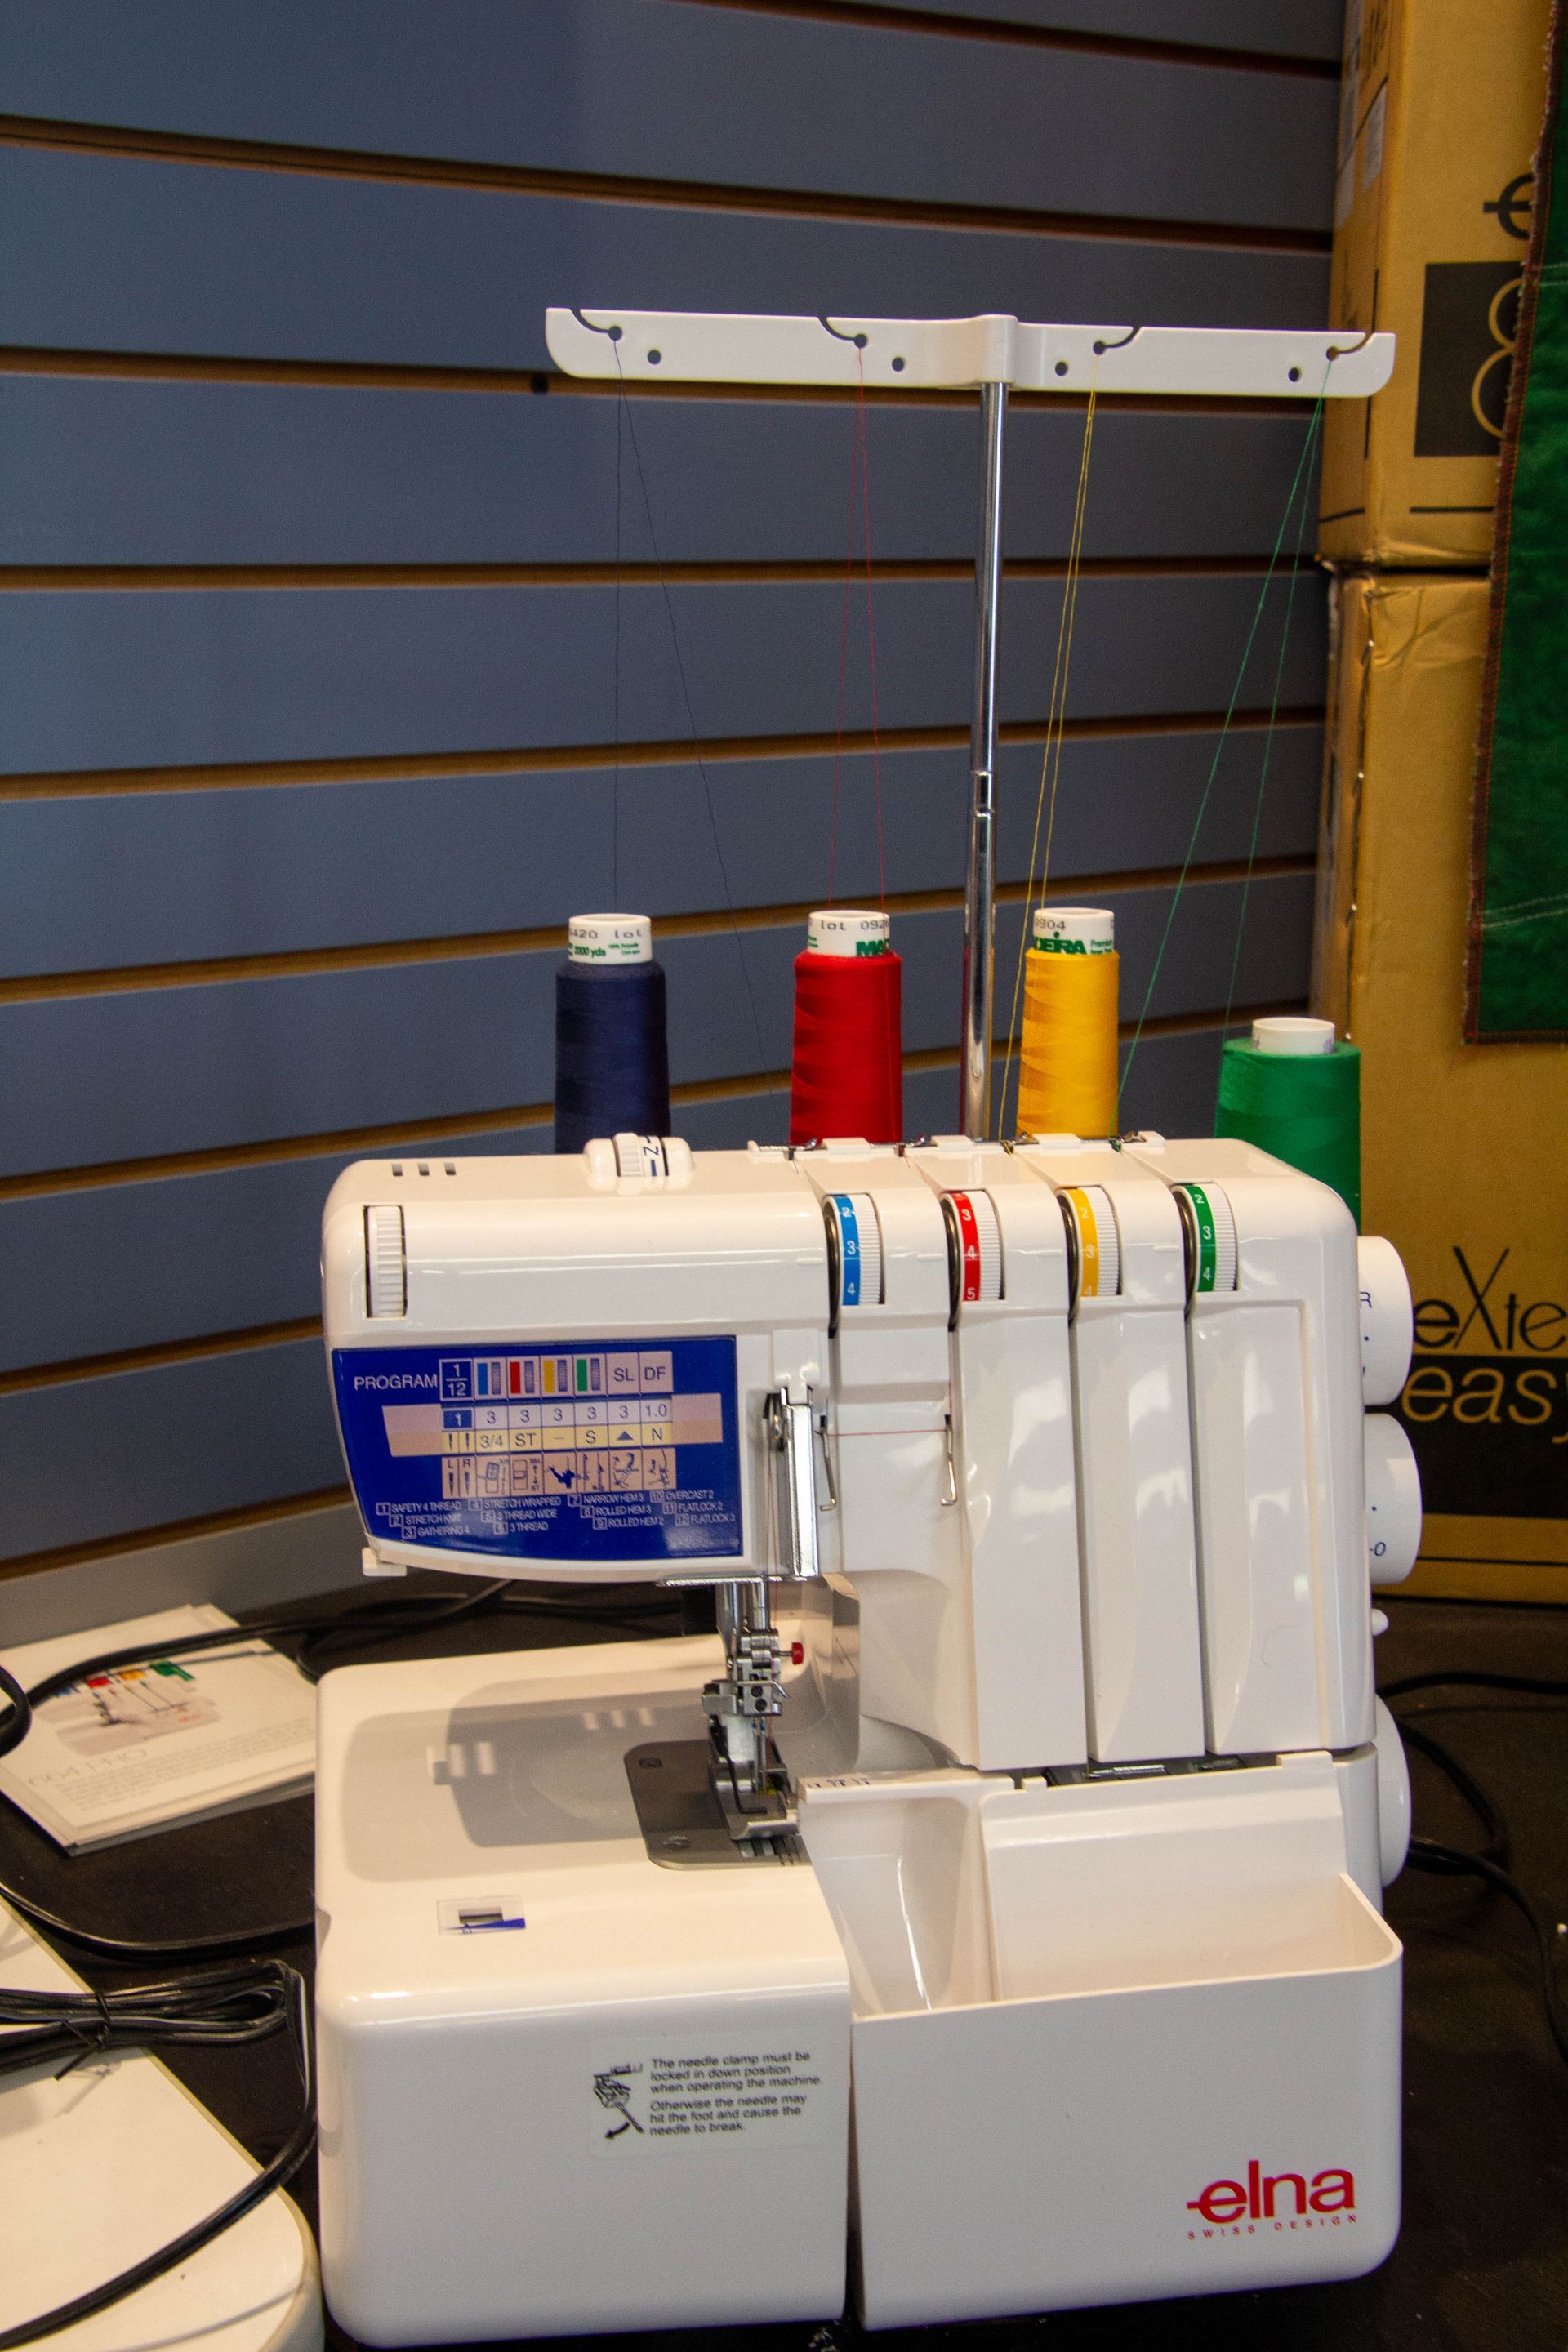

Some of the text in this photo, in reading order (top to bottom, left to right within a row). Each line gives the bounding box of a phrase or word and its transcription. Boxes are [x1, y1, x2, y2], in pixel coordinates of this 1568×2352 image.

[1194, 1193, 1205, 1205] 2
[961, 1208, 973, 1222] 3
[1080, 1206, 1089, 1219] 2
[1201, 1225, 1212, 1241] 3
[846, 1240, 857, 1256] 3
[966, 1244, 977, 1261] 4
[1085, 1244, 1095, 1260] 3
[1201, 1266, 1212, 1281] 4
[846, 1281, 857, 1296] 4
[966, 1286, 976, 1301] 5
[613, 1365, 667, 1383] SL DF
[353, 1374, 439, 1392] PROGRAM
[486, 1410, 497, 1425] 3
[519, 1409, 531, 1423] 3
[553, 1407, 564, 1422] 3
[586, 1406, 598, 1421] 3
[618, 1404, 630, 1419] 3
[645, 1403, 668, 1418] 1.0
[480, 1435, 505, 1450] 3/4
[514, 1432, 537, 1448] ST
[585, 1429, 597, 1445] S
[651, 1427, 664, 1441] N
[447, 1458, 471, 1469] L R
[583, 1494, 618, 1504] NARROW
[666, 1489, 708, 1501] OVERCAST
[391, 1503, 422, 1513] SAFETY
[430, 1501, 462, 1512] THREAD
[483, 1498, 521, 1509] STRETCH
[595, 1505, 627, 1517] ROLLED
[627, 1503, 646, 1515] HEM
[404, 1514, 442, 1526] STRETCH
[504, 1509, 537, 1521] THREAD
[608, 1517, 639, 1528] ROLLED
[417, 1525, 465, 1537] GATHERING
[517, 1521, 550, 1532] THREAD
[652, 2051, 811, 2069] The needle clamp must be
[651, 2065, 791, 2082] locked in down position
[651, 2083, 684, 2093] when
[687, 2079, 744, 2093] operating
[747, 2078, 766, 2089] the
[651, 2093, 808, 2112] Otherwise the needle may
[650, 2105, 802, 2123] hit the foot and cause the
[650, 2123, 691, 2136] needle
[694, 2123, 706, 2134] to
[1187, 2159, 1356, 2224] elna
[1188, 2214, 1358, 2241] SWISS DESIGN
